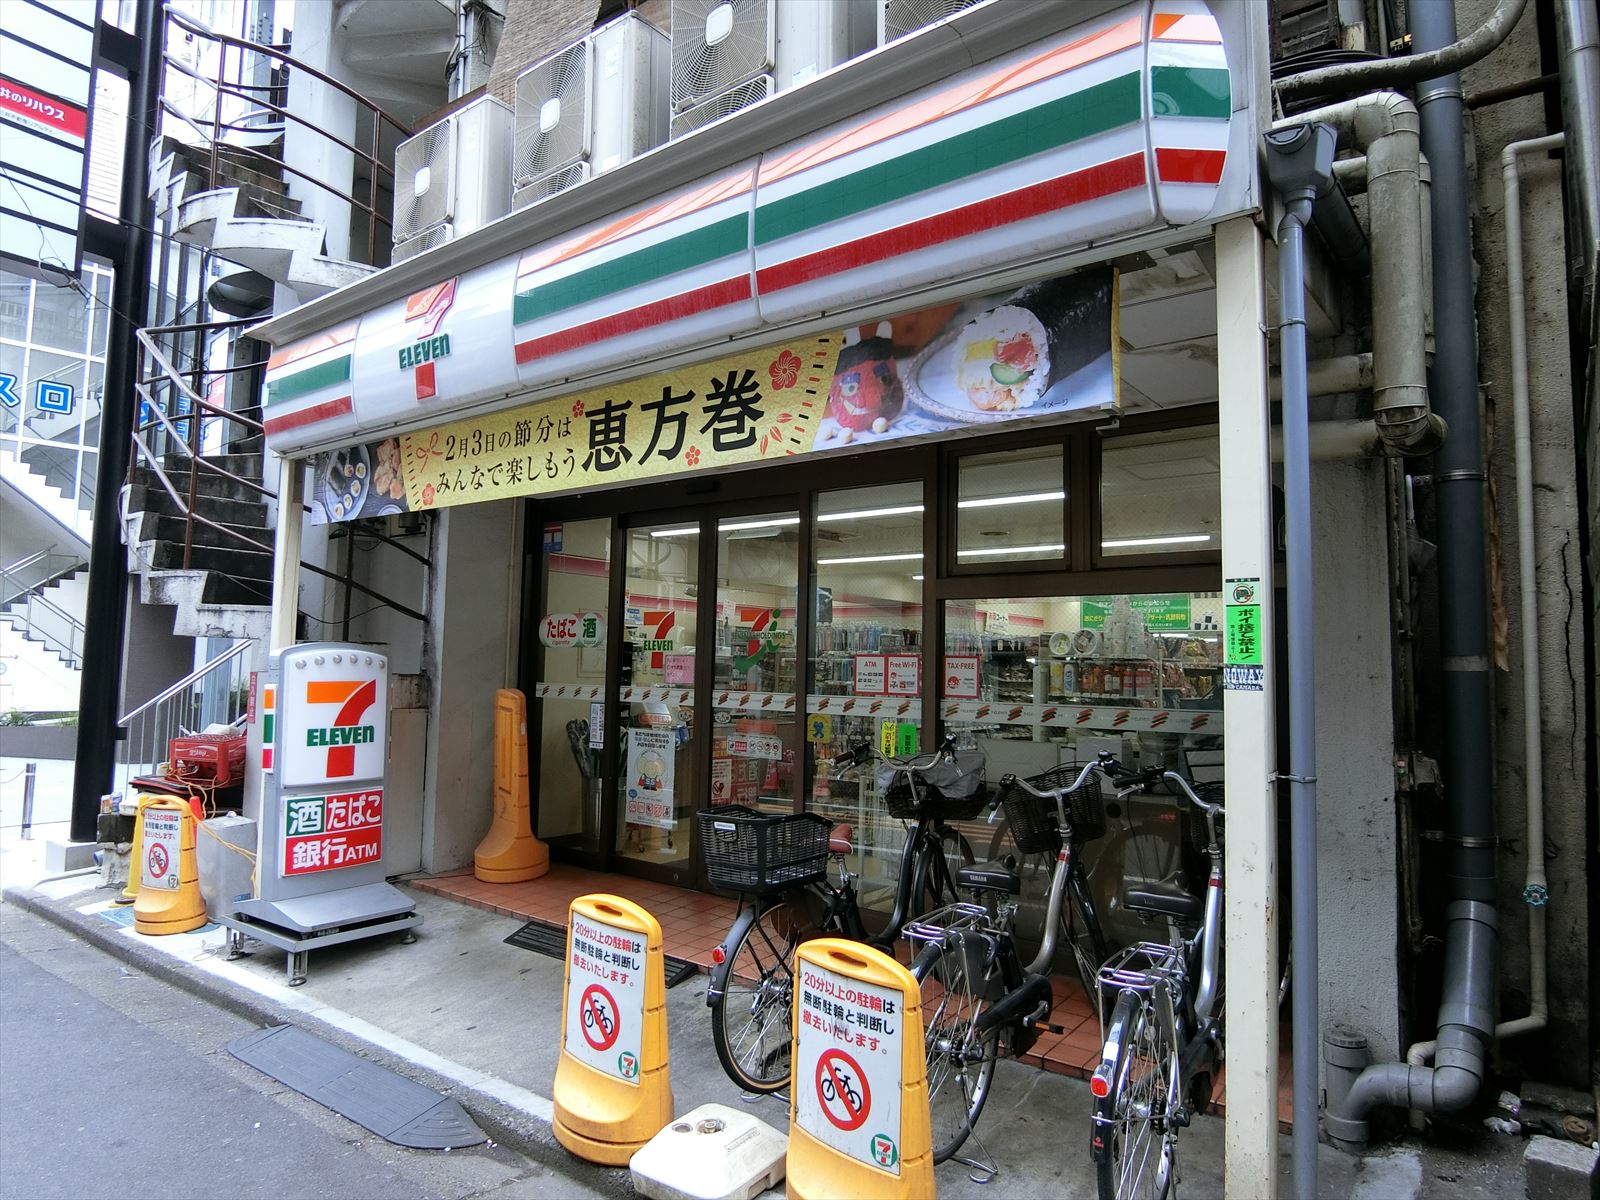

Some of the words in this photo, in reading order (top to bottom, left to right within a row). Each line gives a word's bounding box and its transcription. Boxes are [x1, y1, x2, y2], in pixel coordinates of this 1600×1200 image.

[444, 414, 573, 462] 2月3日の節分は
[581, 368, 765, 473] 恵方巻
[436, 447, 575, 495] みんなで楽しもう
[546, 618, 577, 639] たばこ
[582, 617, 597, 639] 酒
[643, 611, 675, 669] 7
[863, 660, 877, 668] ATM
[902, 661, 917, 669] Wi-Fi
[306, 679, 377, 778] 7
[288, 800, 324, 835] 酒
[327, 794, 381, 830] たばこ
[574, 937, 640, 971] 無断駐輪と判断し
[575, 921, 642, 954] 20分以上の駐輪は
[803, 990, 895, 1036] 無断駐輪と判断し
[804, 971, 896, 1015] 20分以上の駐輪は
[802, 1010, 888, 1055] 撤去いたします。
